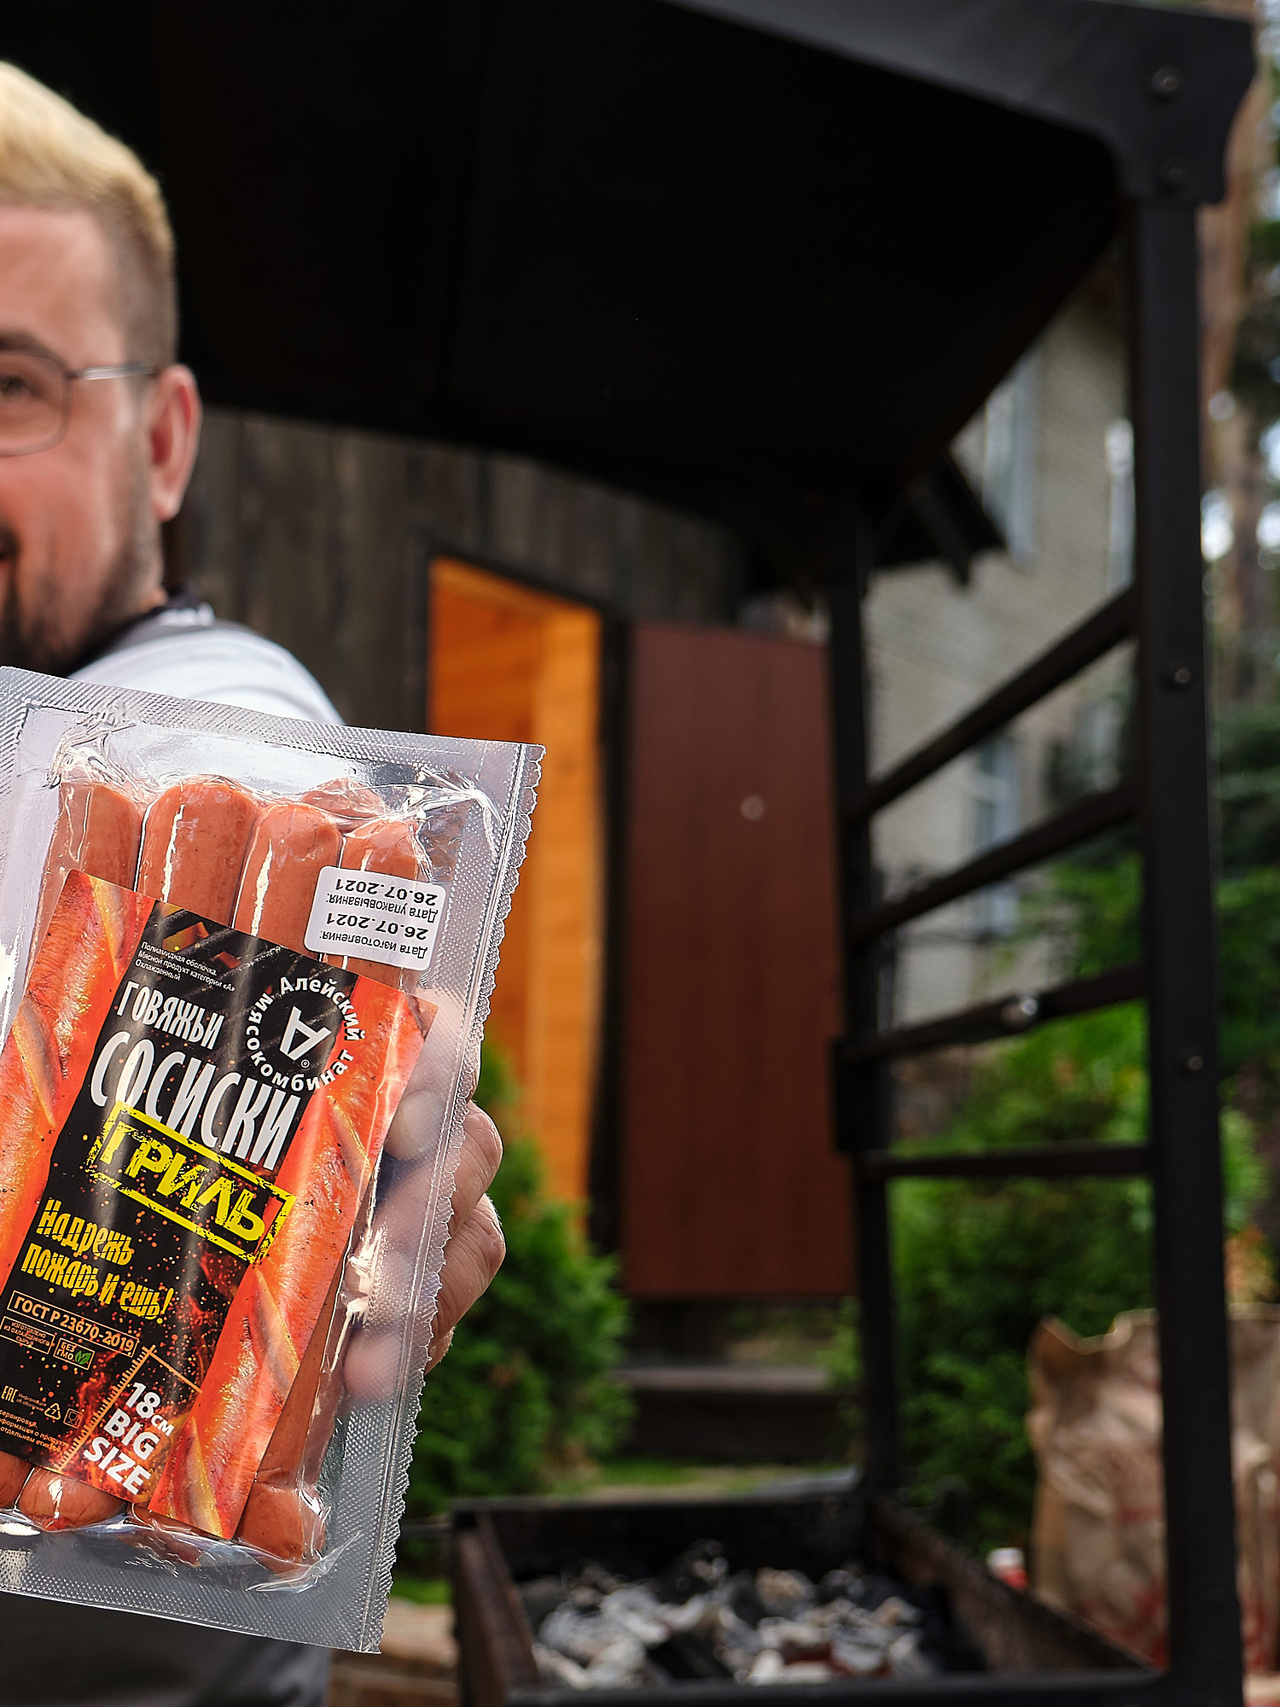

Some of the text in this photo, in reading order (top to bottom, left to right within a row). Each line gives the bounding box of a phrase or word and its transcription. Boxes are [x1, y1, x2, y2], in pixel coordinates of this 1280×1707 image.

[326, 893, 439, 923] Дата упаковывания:
[335, 878, 438, 906] 26.07.2021
[319, 930, 428, 959] Дата изготовления:
[326, 912, 429, 940] 26.07.2021
[135, 959, 181, 981] Охлажденный
[138, 950, 162, 965] Мясной
[163, 960, 190, 974] продукт
[190, 970, 222, 987] категории
[117, 980, 225, 1050] ГОВЯЖЬИ
[280, 976, 365, 1041] Алейский
[246, 992, 354, 1092] мясокомбинат
[90, 1031, 301, 1171] СОСИСКИ
[99, 1121, 266, 1242] ГРИЛЬ
[36, 1199, 132, 1265] Надрежь
[14, 1296, 50, 1319] ГОСТ
[60, 1314, 134, 1352] 23670-2019
[61, 1342, 76, 1352] БЕЗ
[56, 1349, 74, 1360] ГМО
[103, 1408, 160, 1460] BIG
[83, 1437, 151, 1495] SIZE
